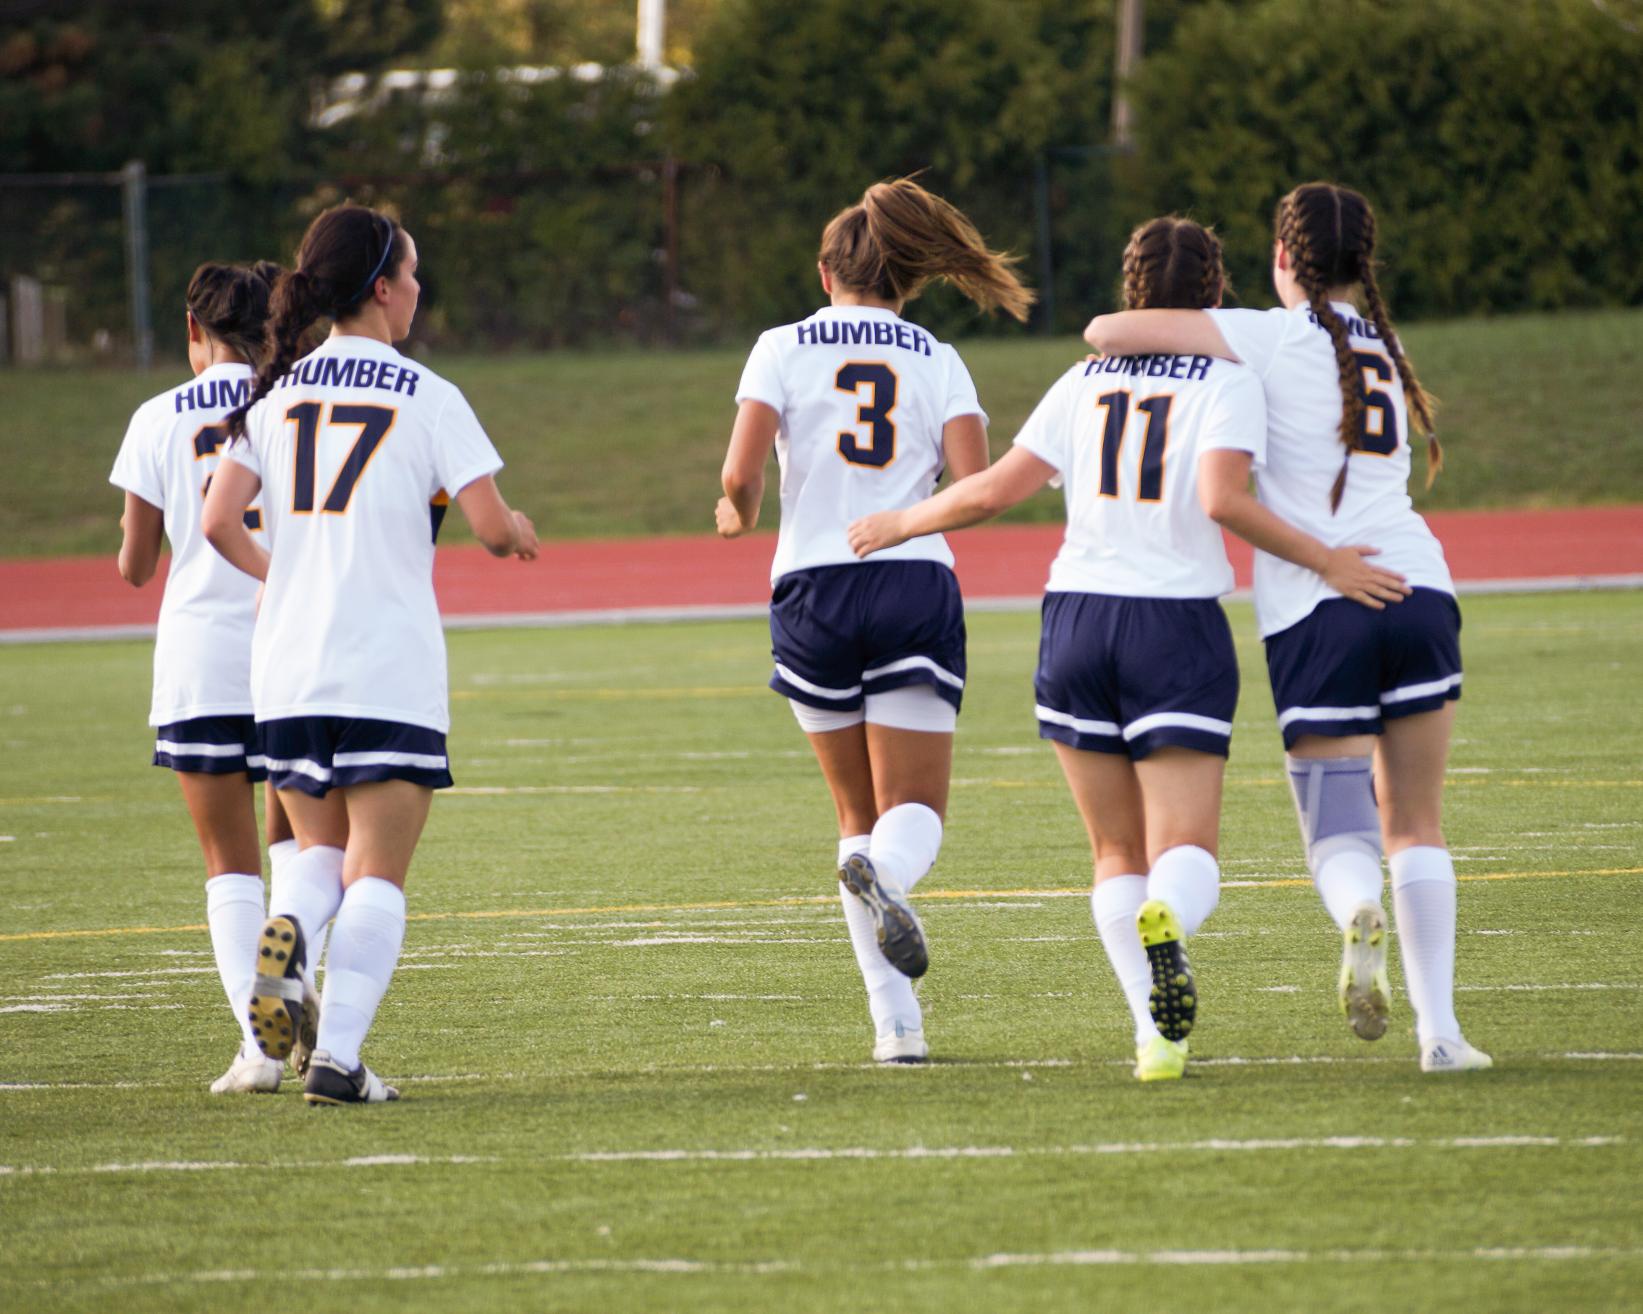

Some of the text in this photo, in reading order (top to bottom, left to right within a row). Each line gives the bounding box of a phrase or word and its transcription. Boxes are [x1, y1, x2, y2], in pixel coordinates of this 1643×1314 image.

[797, 319, 931, 356] HUMBER
[1084, 354, 1213, 380] HUMBER
[175, 378, 255, 413] HUM
[281, 357, 420, 397] HUMBER
[1350, 347, 1400, 458] 6
[834, 359, 899, 471] 3
[1096, 387, 1176, 503] 11
[285, 400, 398, 516] 17
